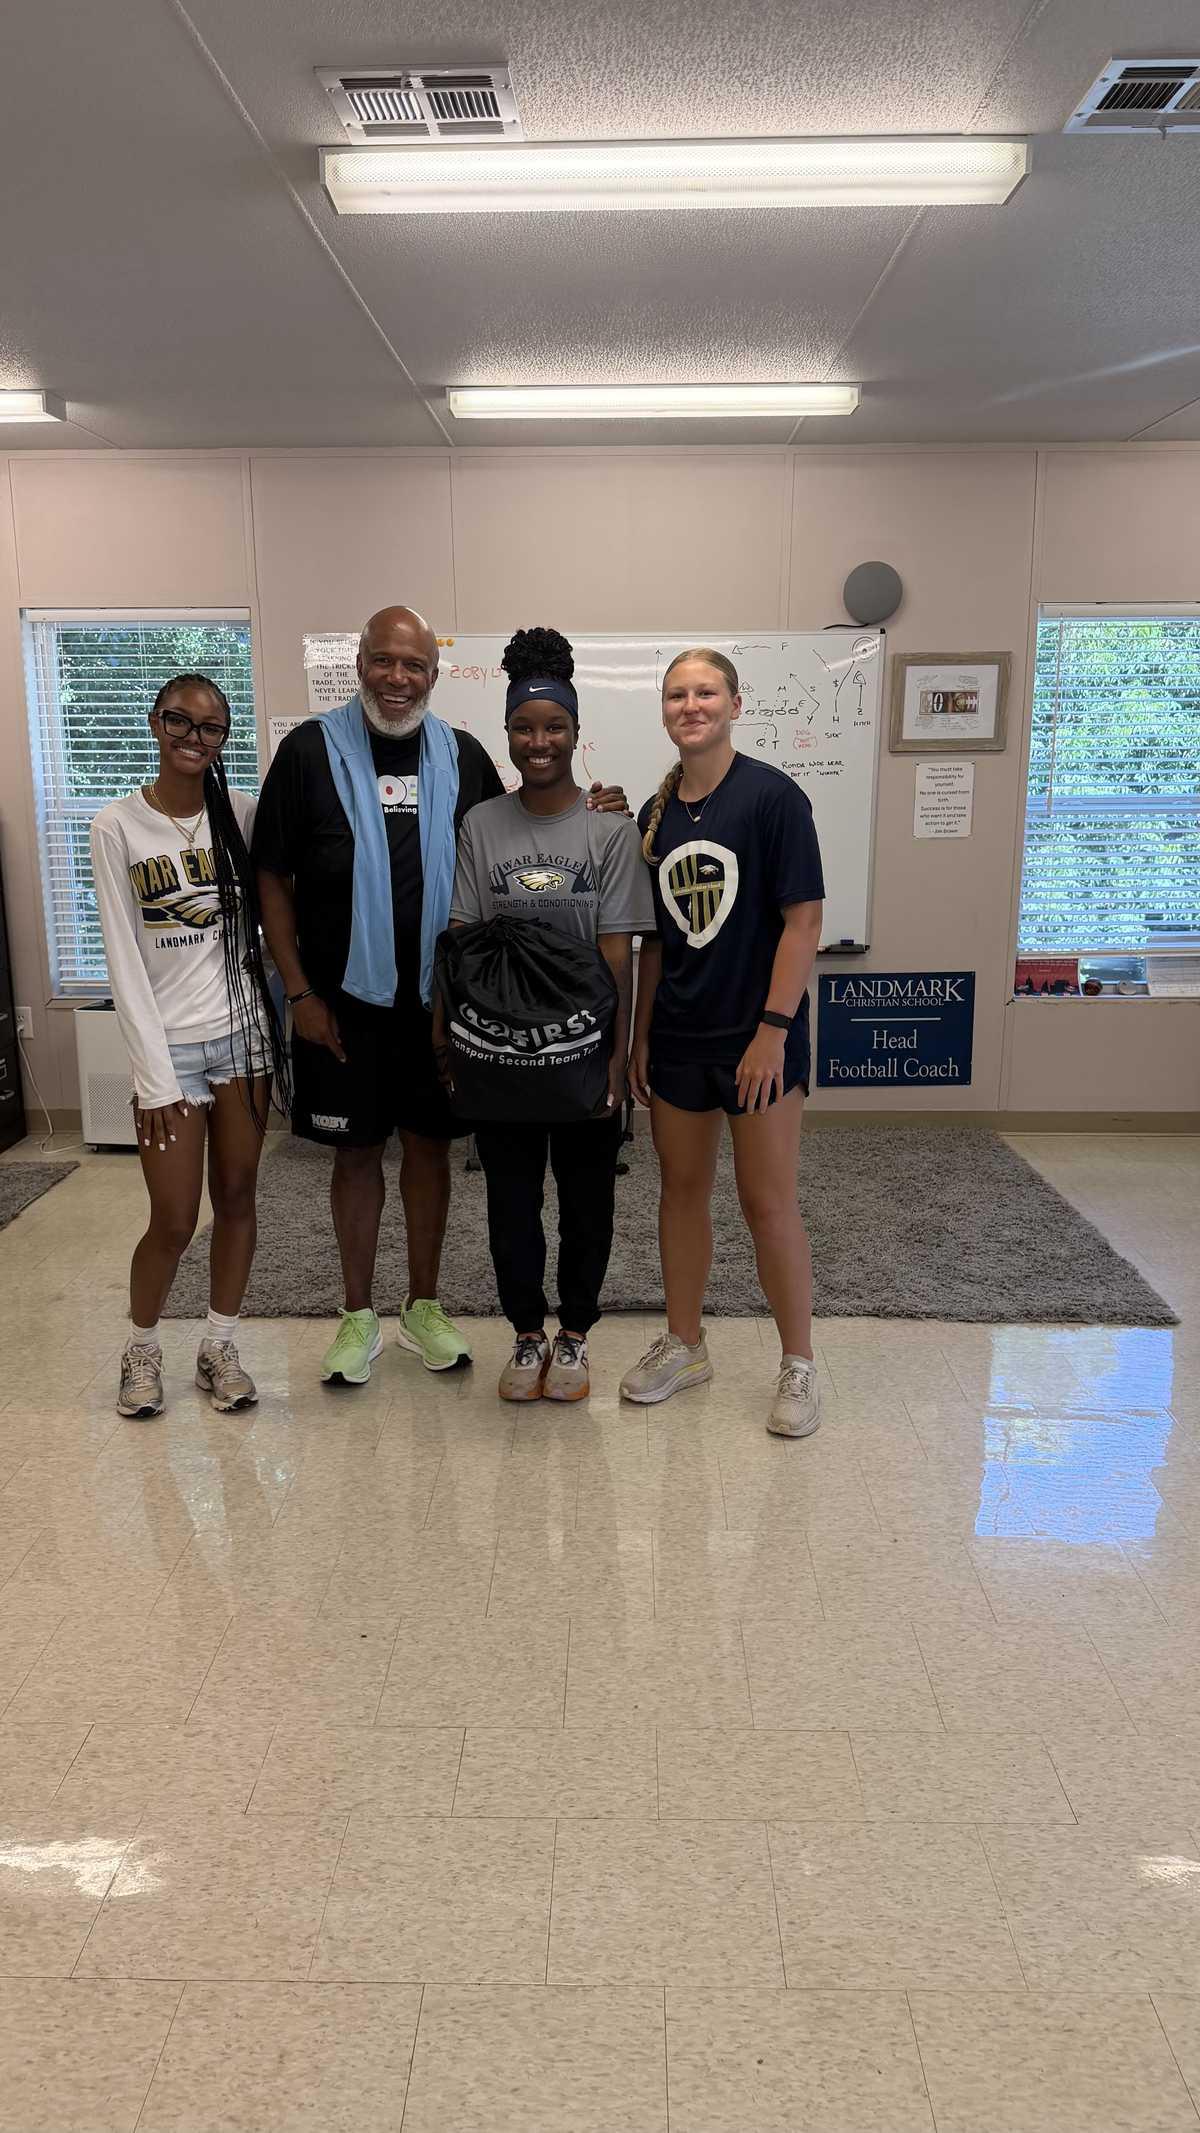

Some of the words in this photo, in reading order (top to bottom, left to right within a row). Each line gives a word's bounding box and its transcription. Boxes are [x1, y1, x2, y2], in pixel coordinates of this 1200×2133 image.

[312, 679, 336, 687] TRADE,
[383, 805, 418, 815] Believing
[502, 854, 532, 872] WAR
[535, 853, 583, 873] EAGLE
[128, 854, 182, 903] WAR
[491, 899, 528, 910] STRENGTH
[529, 900, 537, 909] &
[537, 898, 595, 909] CONDITIONING
[155, 932, 205, 949] LANDMARK
[827, 978, 966, 1004] LANDMARK
[845, 998, 900, 1008] CHRISTIAN
[901, 997, 945, 1007] SCHOOL
[872, 1028, 918, 1050] Head
[450, 1032, 495, 1063] ransport
[498, 1054, 546, 1067] Second
[549, 1053, 581, 1066] Team
[828, 1057, 898, 1079] Football
[903, 1057, 960, 1078] Coach
